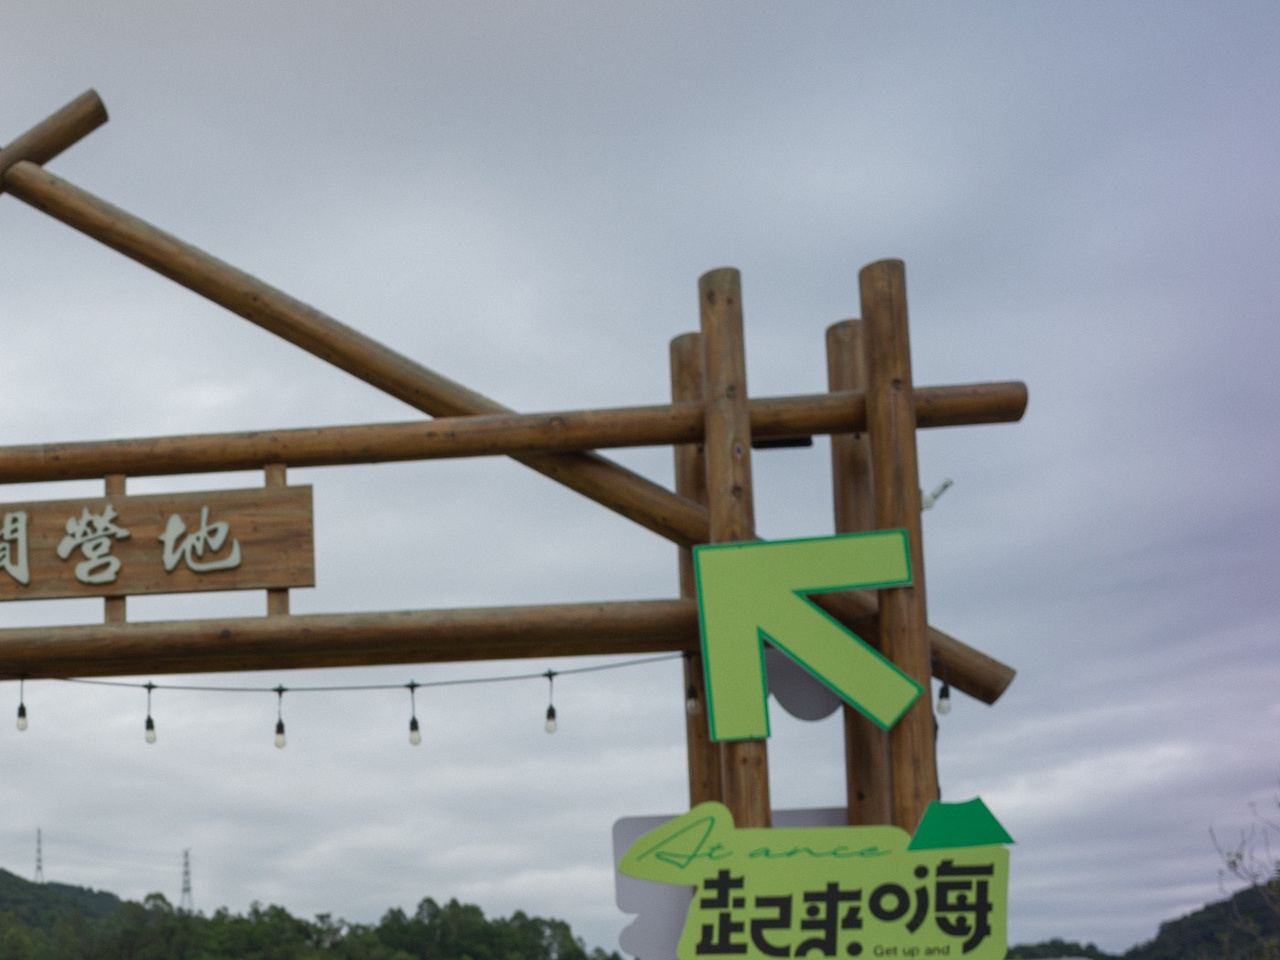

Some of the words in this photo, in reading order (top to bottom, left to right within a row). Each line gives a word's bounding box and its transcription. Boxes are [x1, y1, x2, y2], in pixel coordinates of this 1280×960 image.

[873, 944, 898, 957] Get
[902, 945, 920, 958] up
[924, 944, 951, 956] and
